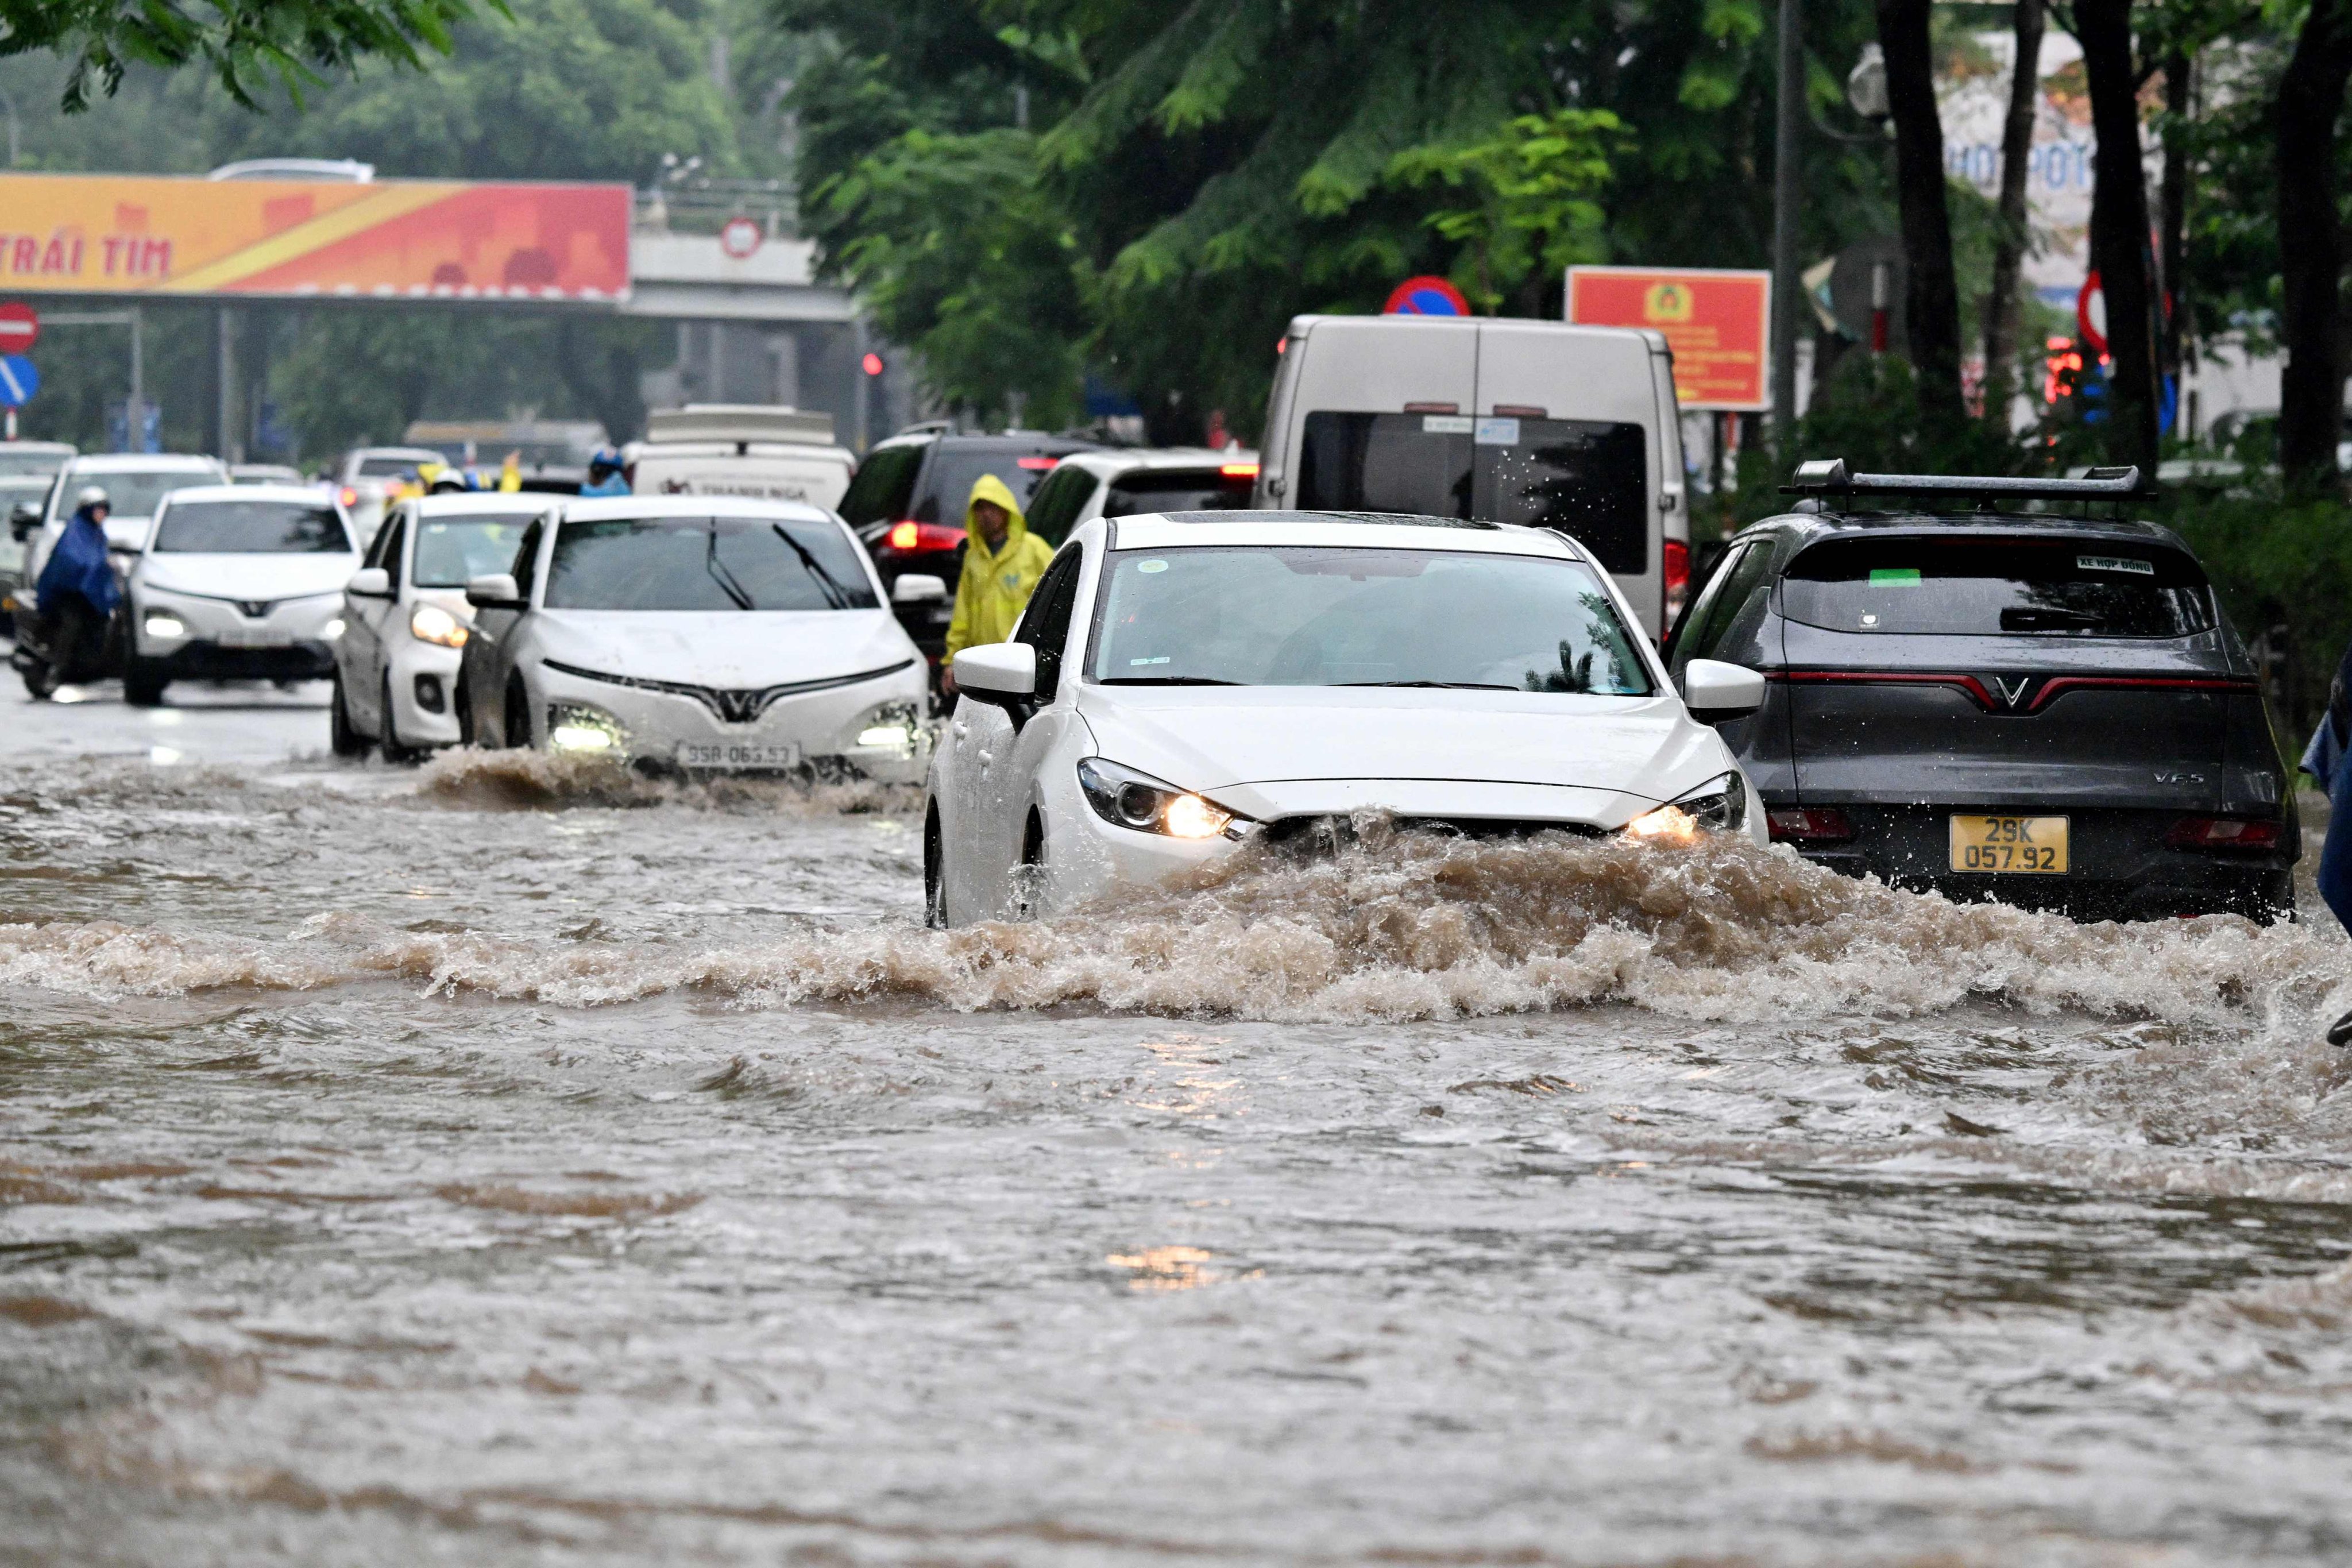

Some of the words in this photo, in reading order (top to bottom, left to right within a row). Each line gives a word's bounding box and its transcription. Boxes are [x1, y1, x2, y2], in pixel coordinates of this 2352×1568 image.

[102, 237, 172, 276] TIM
[2080, 558, 2094, 566] XE
[1985, 818, 2034, 843] 29K
[1965, 845, 2056, 870] 057.92
